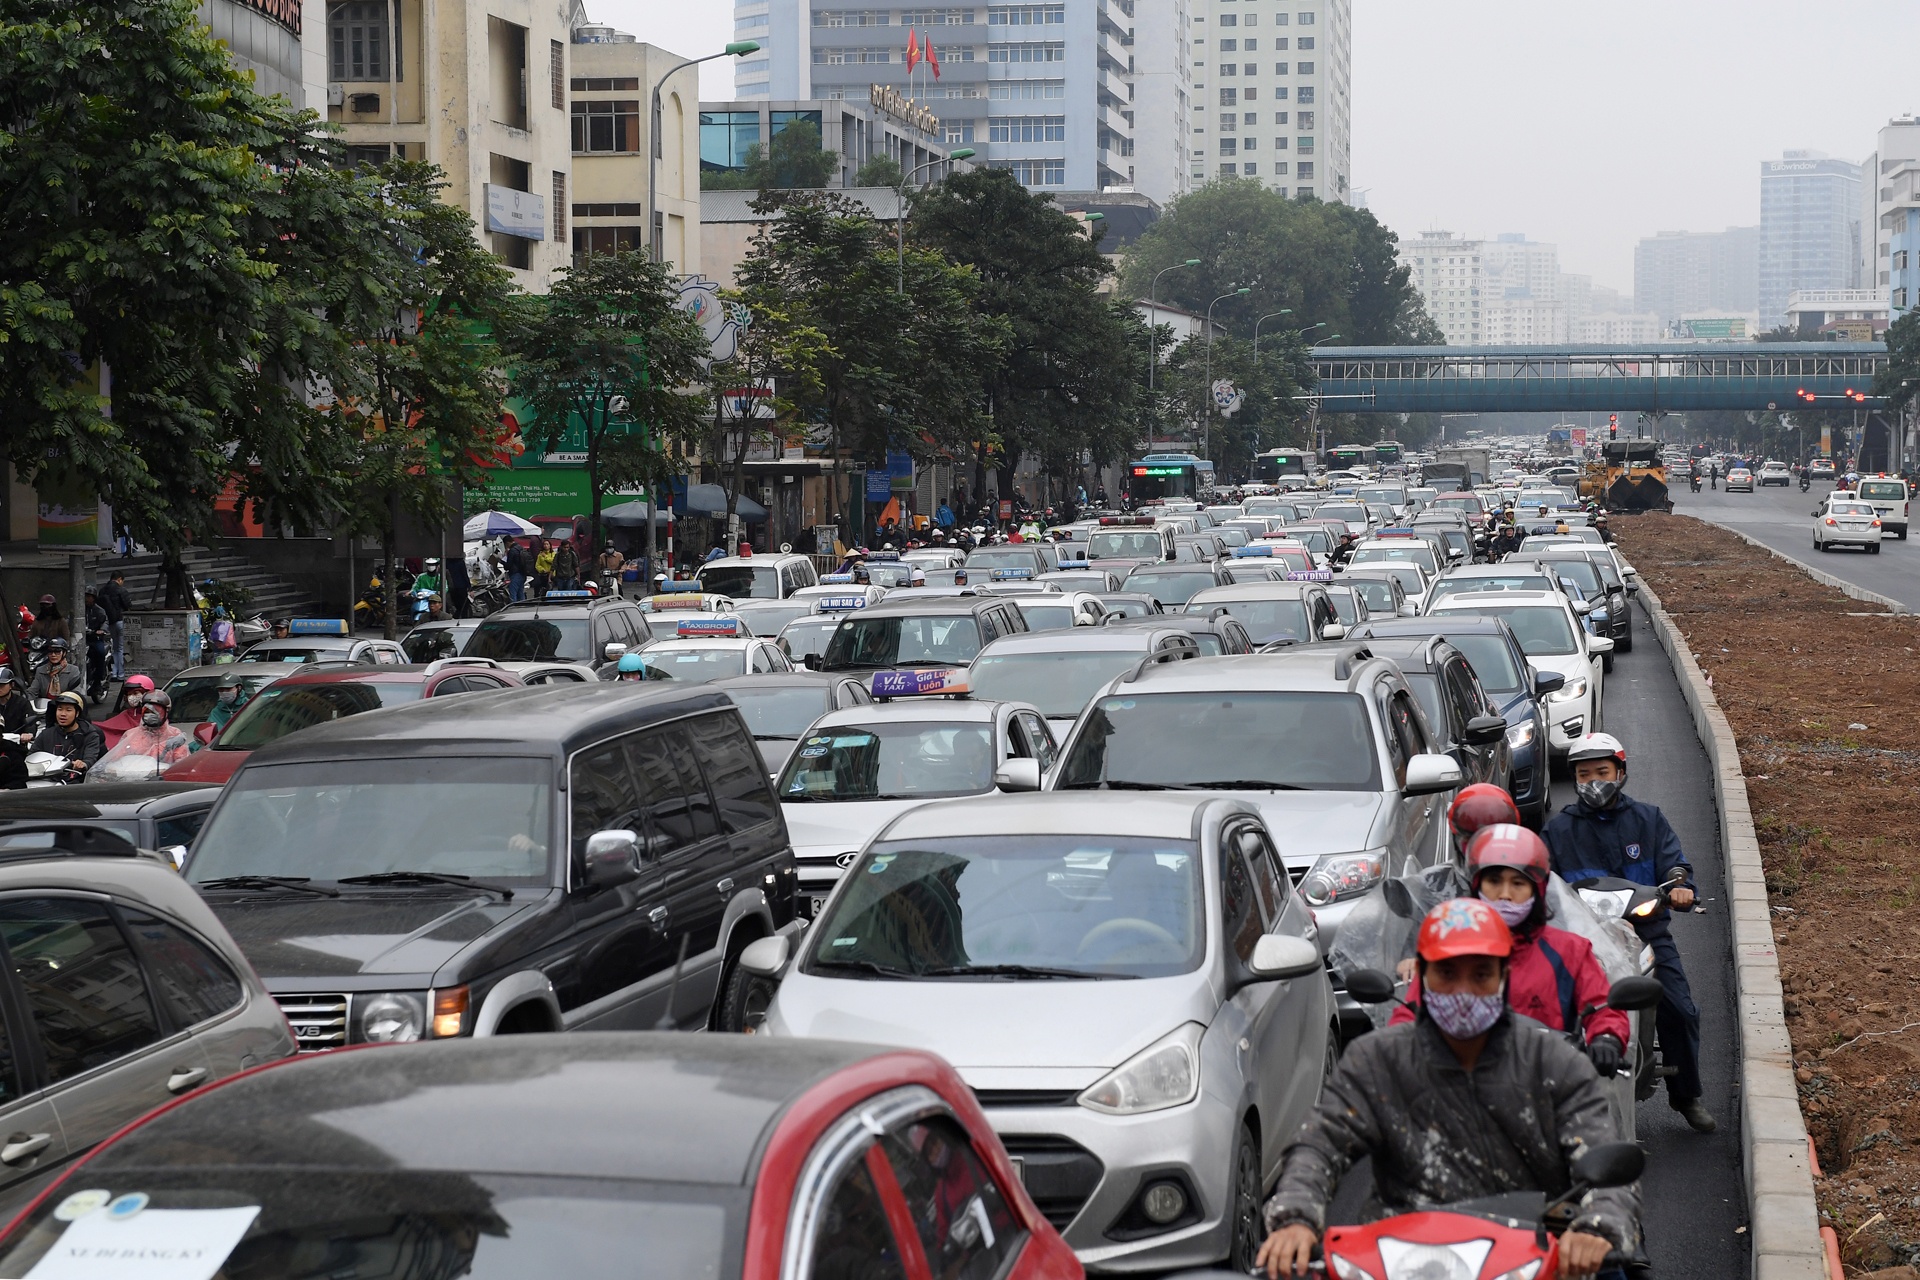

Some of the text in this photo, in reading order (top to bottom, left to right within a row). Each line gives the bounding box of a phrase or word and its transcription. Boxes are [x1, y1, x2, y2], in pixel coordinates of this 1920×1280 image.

[1771, 162, 1817, 171] Eurowindow
[1855, 393, 1864, 401] 66
[916, 673, 932, 683] Giá
[918, 680, 941, 692] Luôn
[293, 1026, 321, 1036] V6
